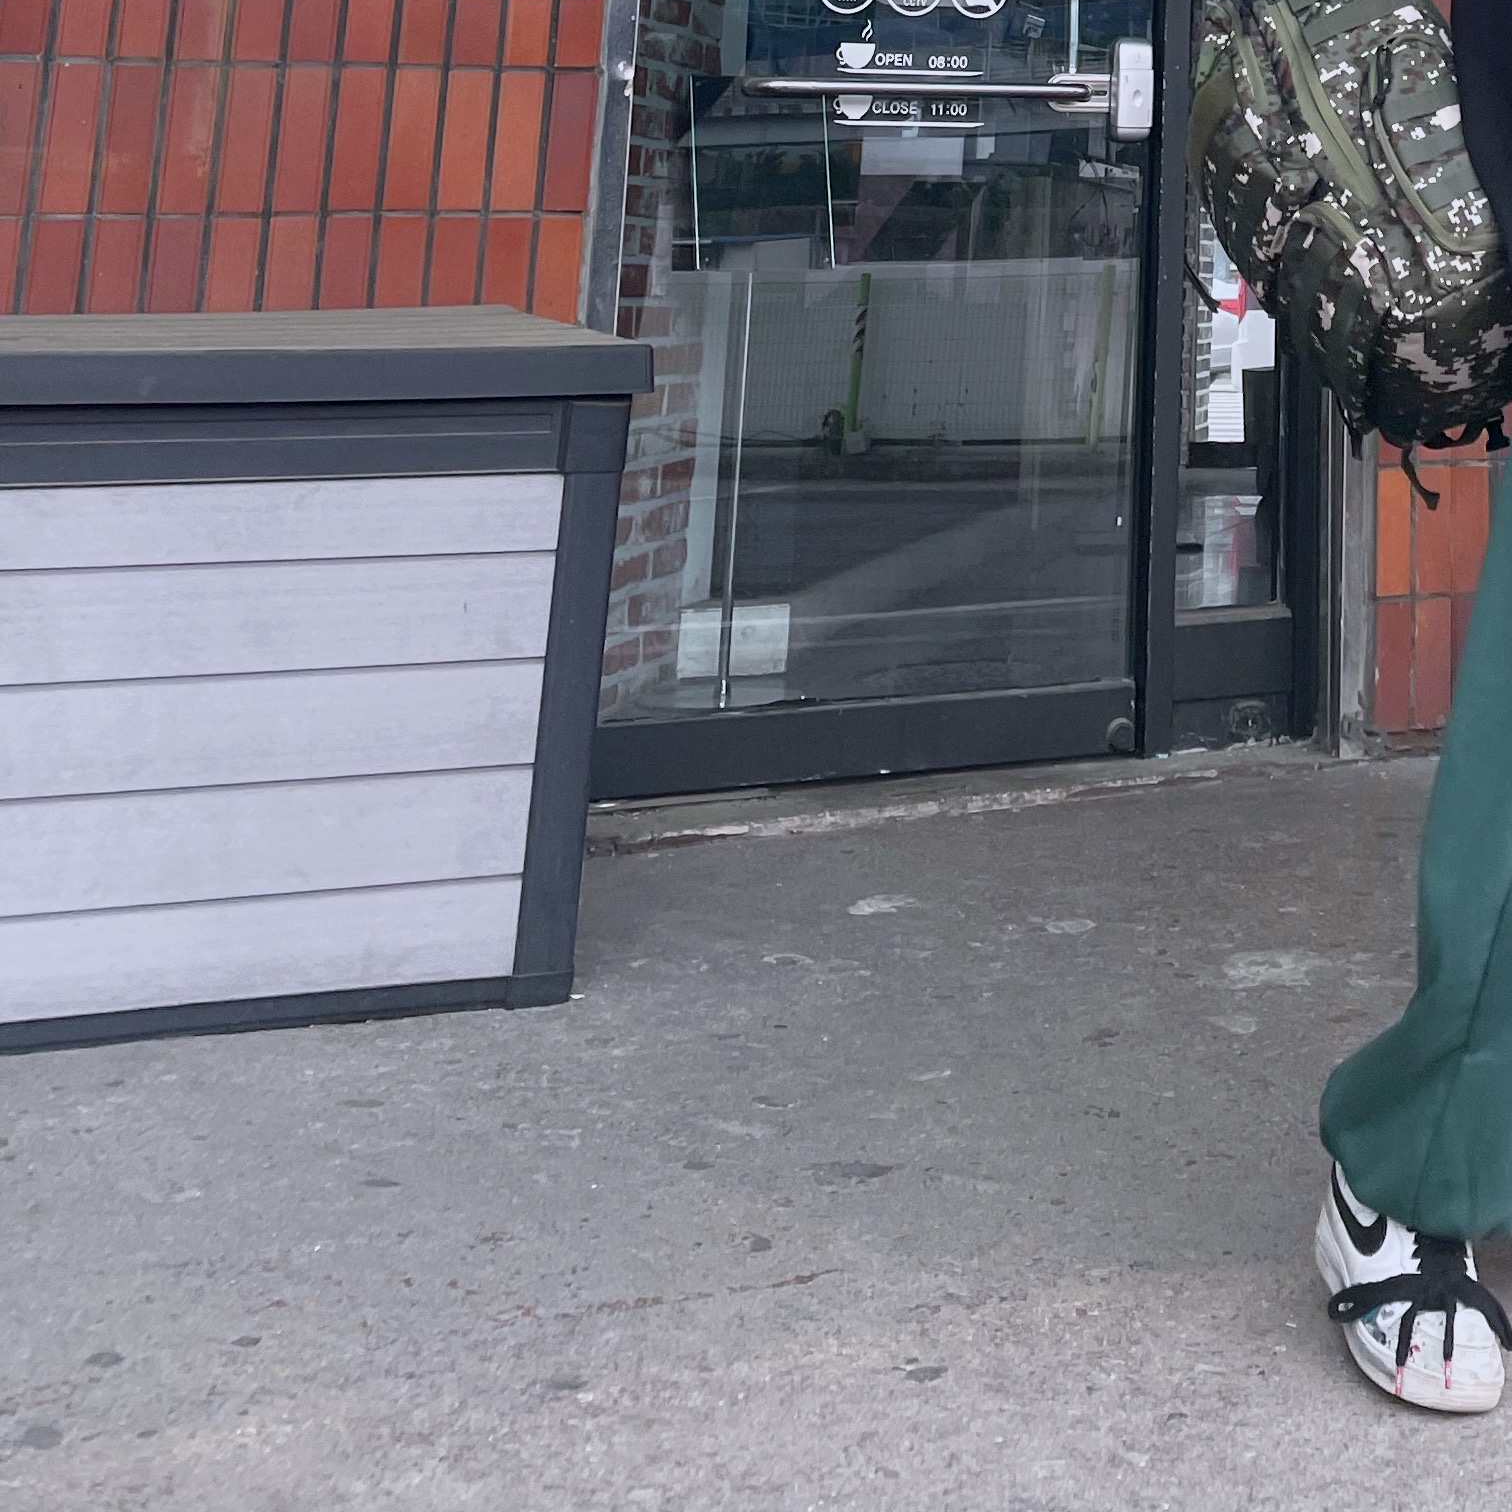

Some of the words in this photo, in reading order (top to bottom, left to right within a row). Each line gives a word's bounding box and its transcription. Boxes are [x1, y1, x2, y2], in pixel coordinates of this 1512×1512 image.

[874, 53, 913, 67] OPEN
[928, 55, 968, 69] 08:00
[872, 100, 918, 115] CLOSE
[930, 103, 968, 117] 11:00
